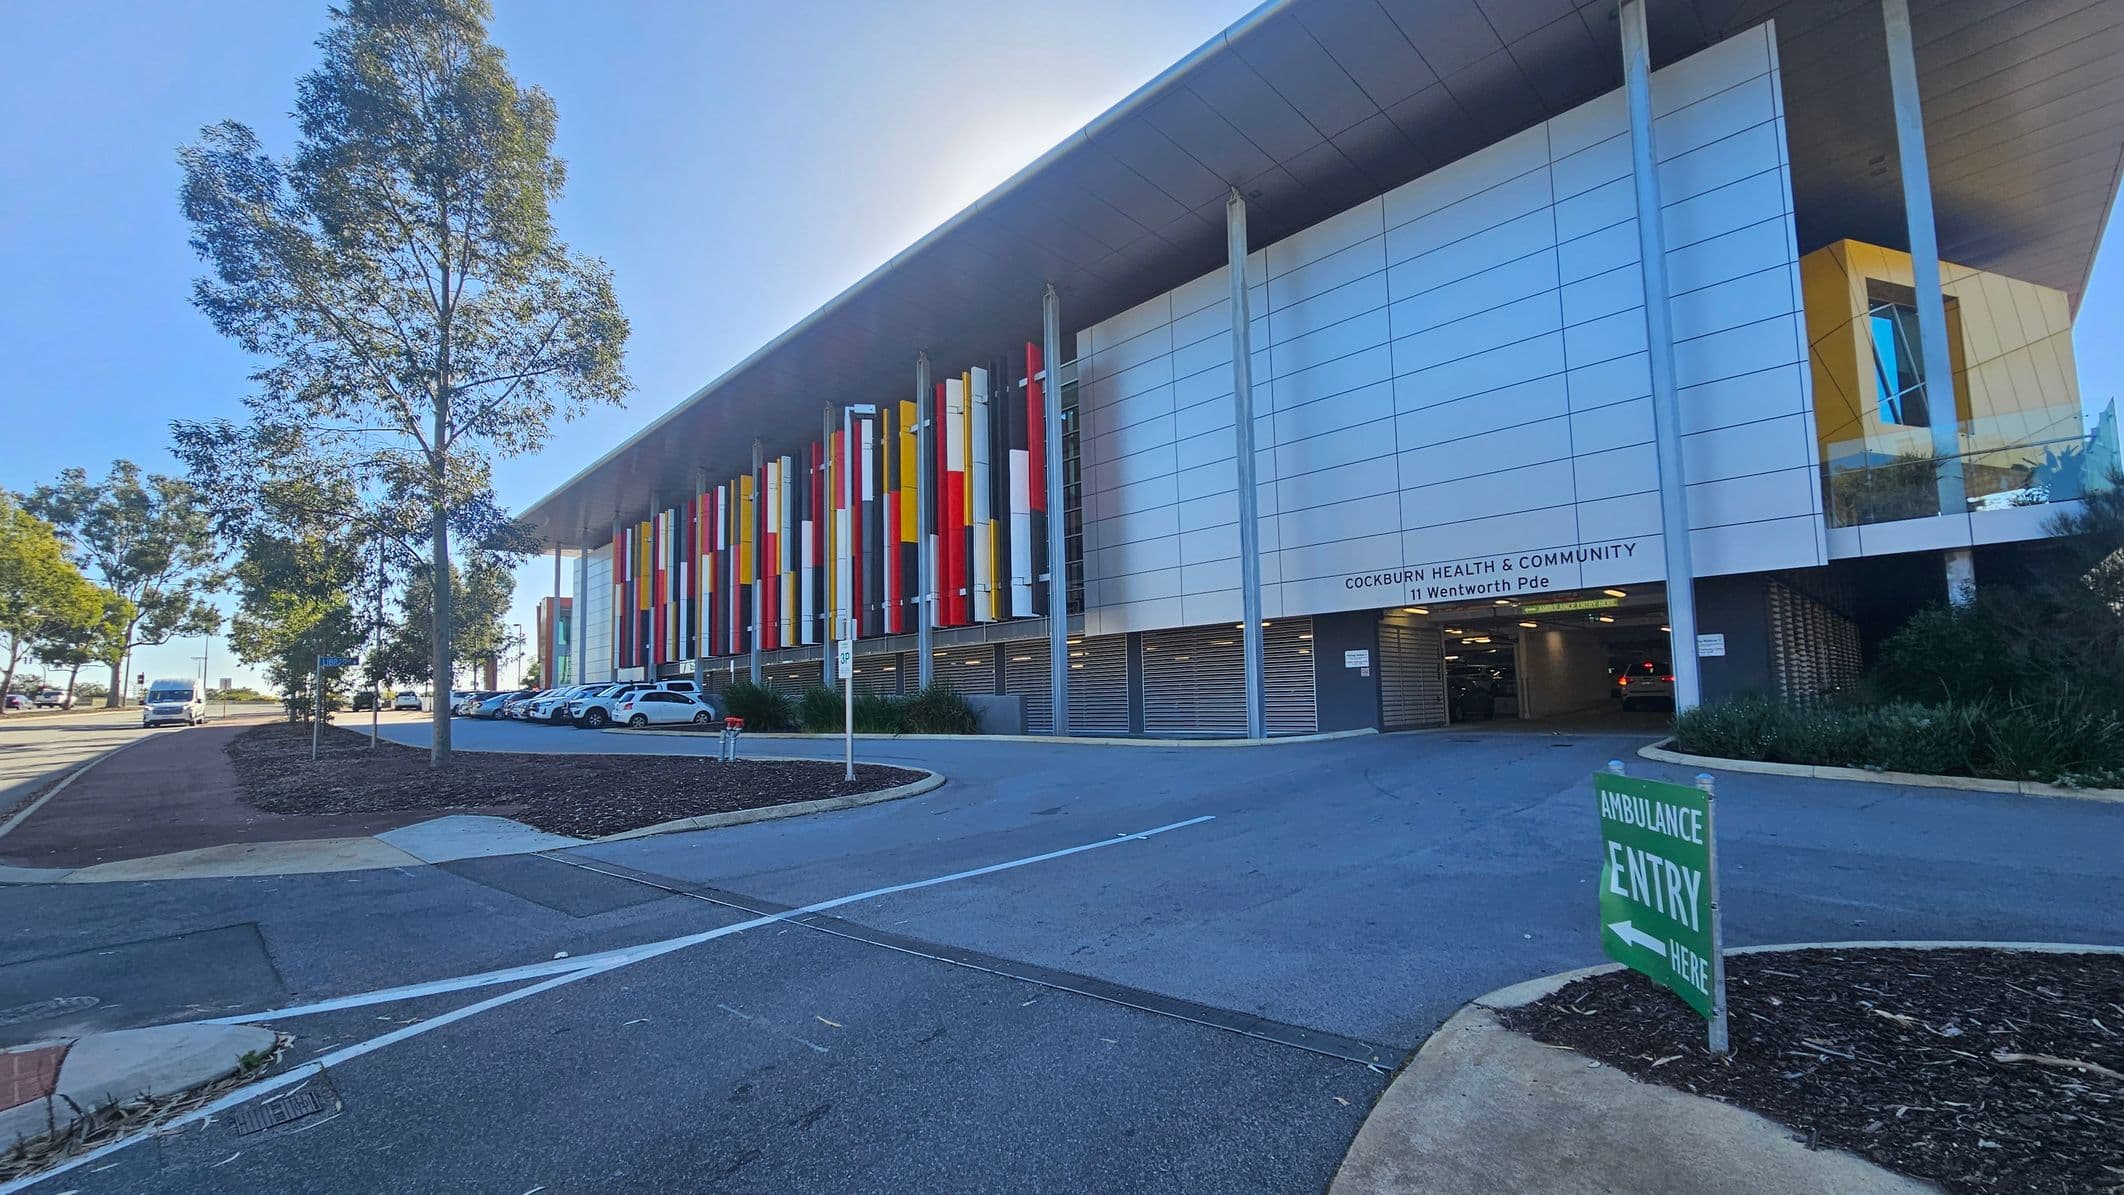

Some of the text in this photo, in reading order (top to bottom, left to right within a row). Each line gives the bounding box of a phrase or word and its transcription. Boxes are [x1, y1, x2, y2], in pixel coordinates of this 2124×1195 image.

[1345, 543, 1636, 589] COCKBURN HEALTH & COMMUNITY
[1410, 576, 1549, 600] 11 Wentworth Pde
[1601, 789, 1703, 845] AMBULANCE
[1608, 840, 1702, 933] ENTRY
[1669, 938, 1709, 995] HERE
